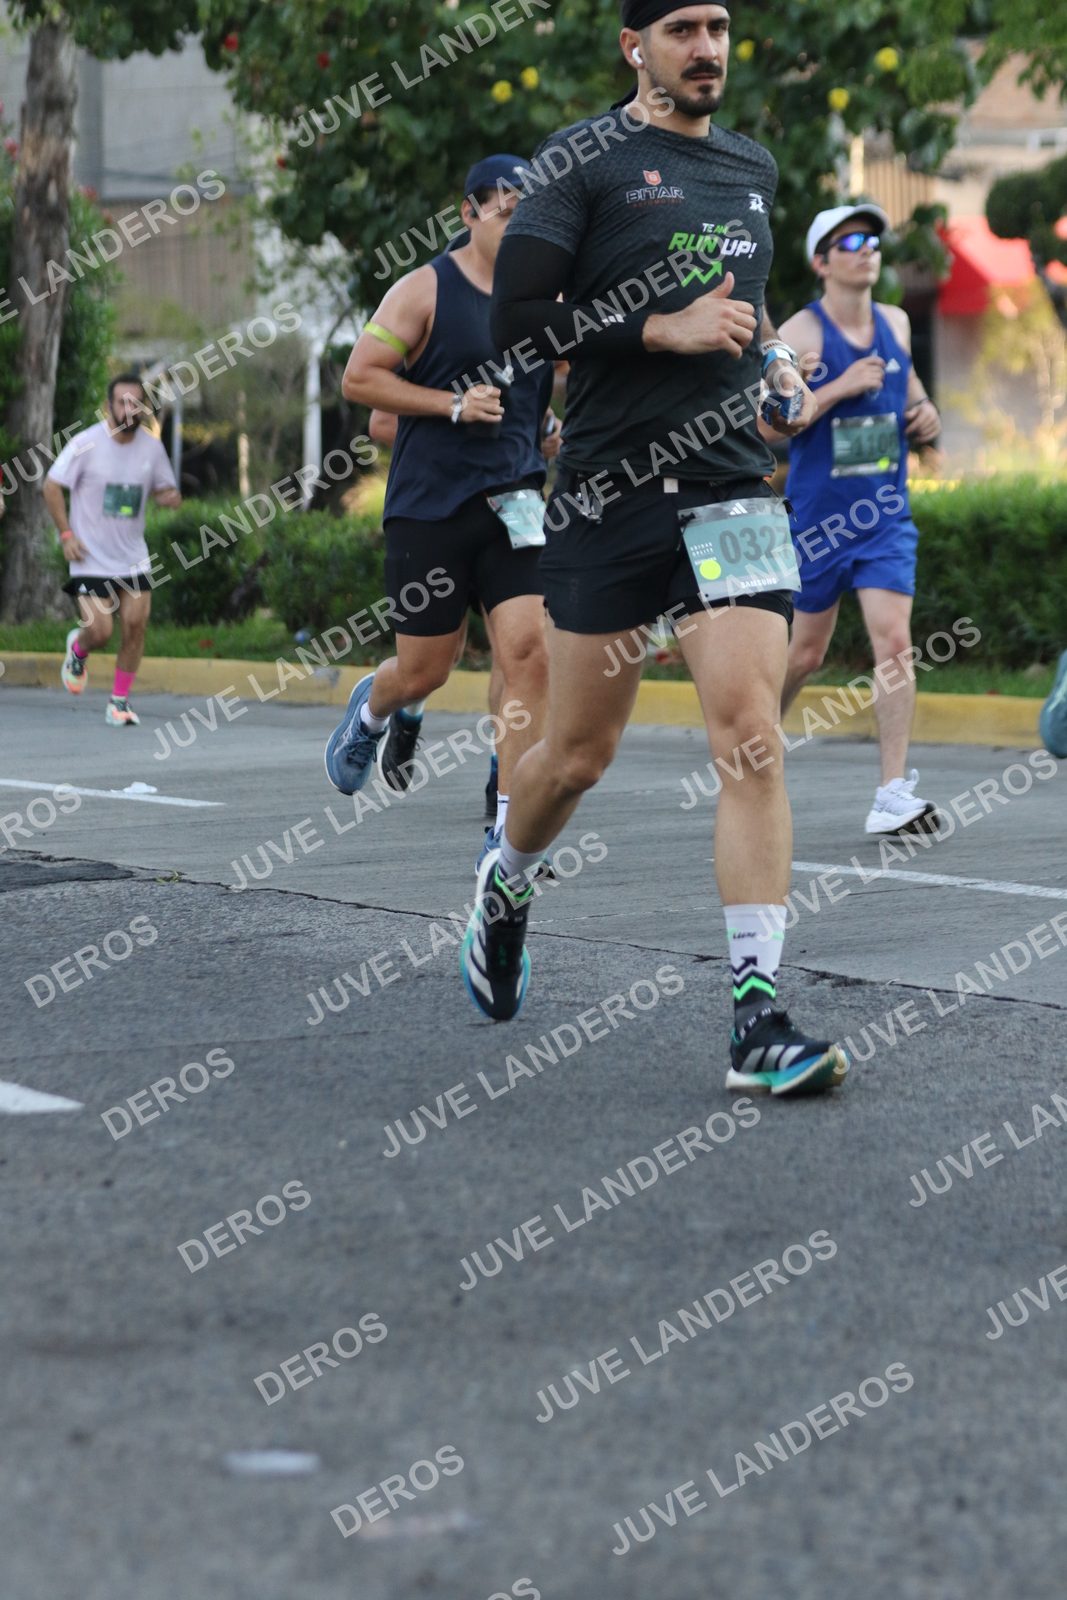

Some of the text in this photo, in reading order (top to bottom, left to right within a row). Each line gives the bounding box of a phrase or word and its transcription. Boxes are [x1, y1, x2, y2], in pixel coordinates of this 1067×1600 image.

[626, 186, 685, 203] BITAR
[702, 223, 729, 235] TEAM
[668, 232, 757, 259] RUN UP!
